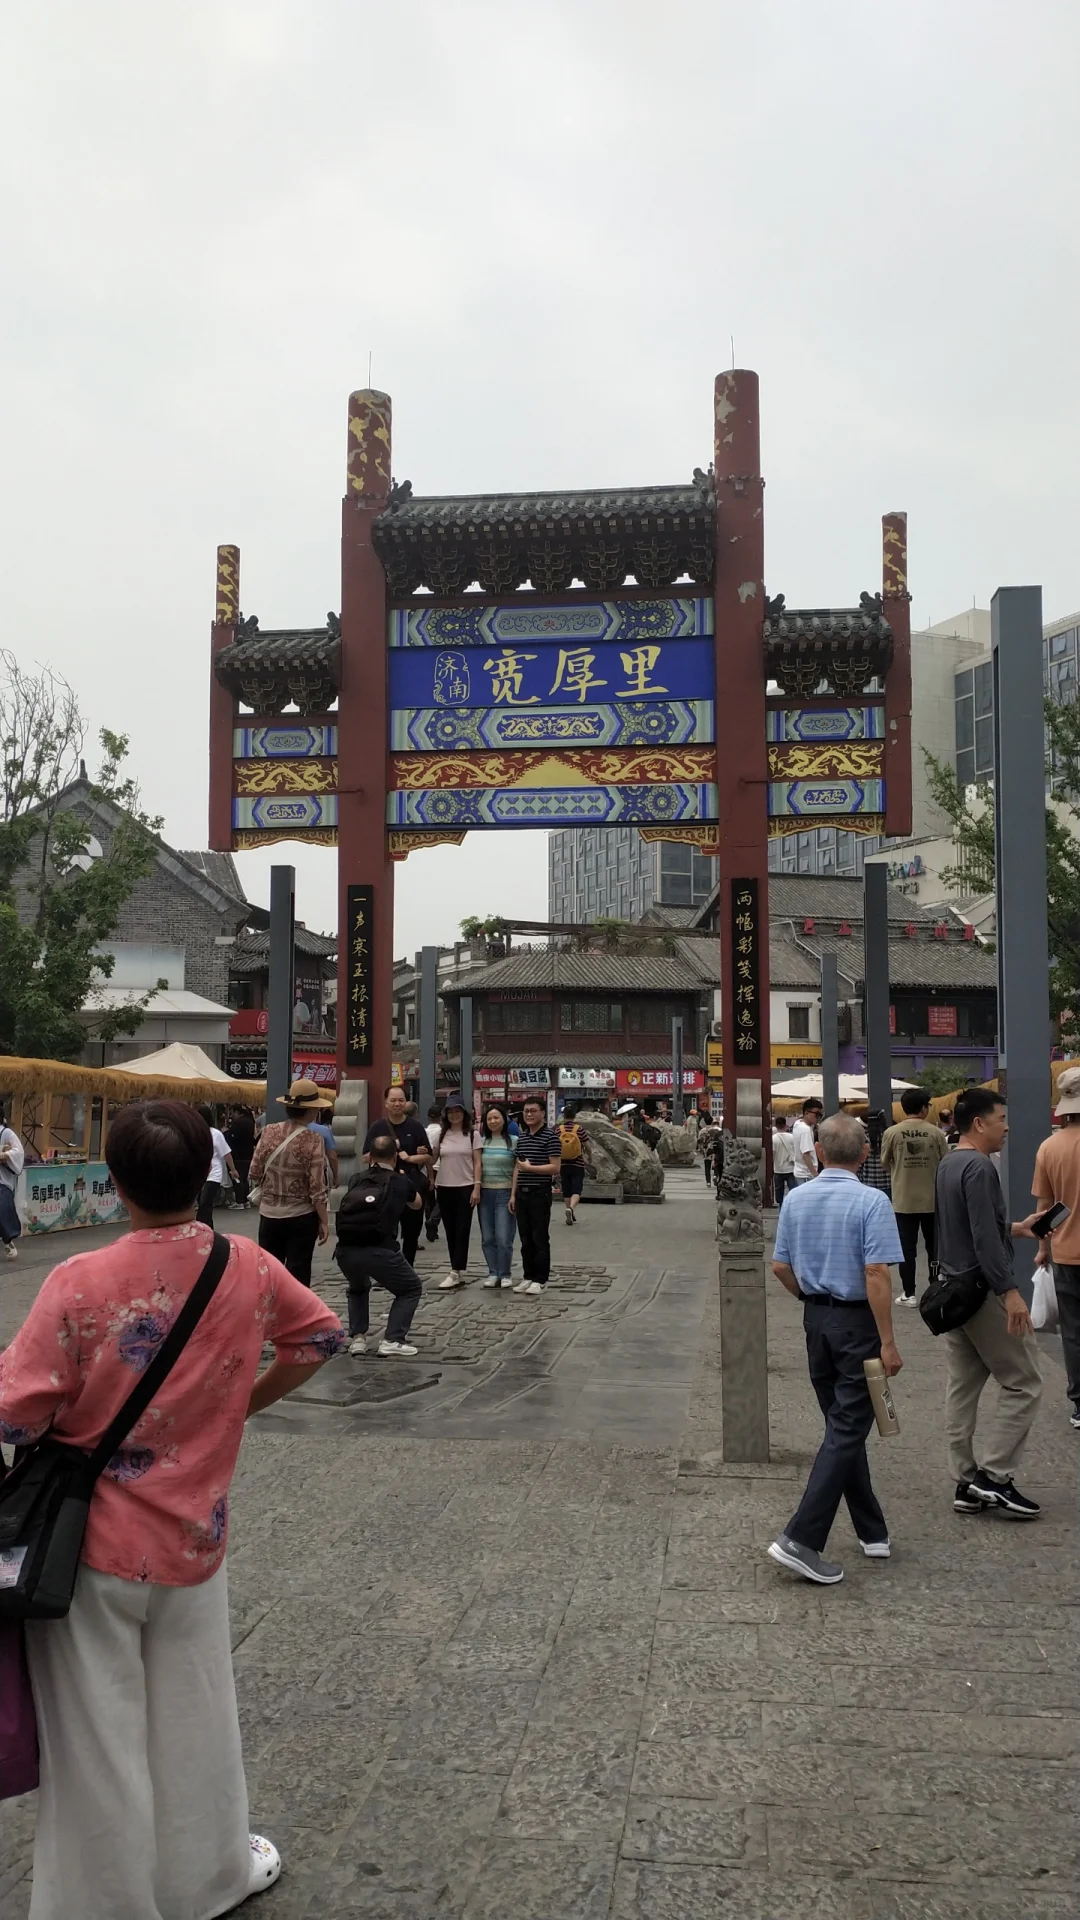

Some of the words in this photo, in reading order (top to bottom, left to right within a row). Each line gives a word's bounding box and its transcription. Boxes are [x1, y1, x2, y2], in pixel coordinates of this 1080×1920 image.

[438, 655, 467, 699] 济南
[482, 645, 668, 705] 宽厚里
[350, 897, 369, 1054] 一声寒玉振清辞
[519, 1070, 548, 1083] 臭豆腐
[901, 1130, 929, 1138] Nike
[32, 1183, 66, 1203] 宽厚里市集
